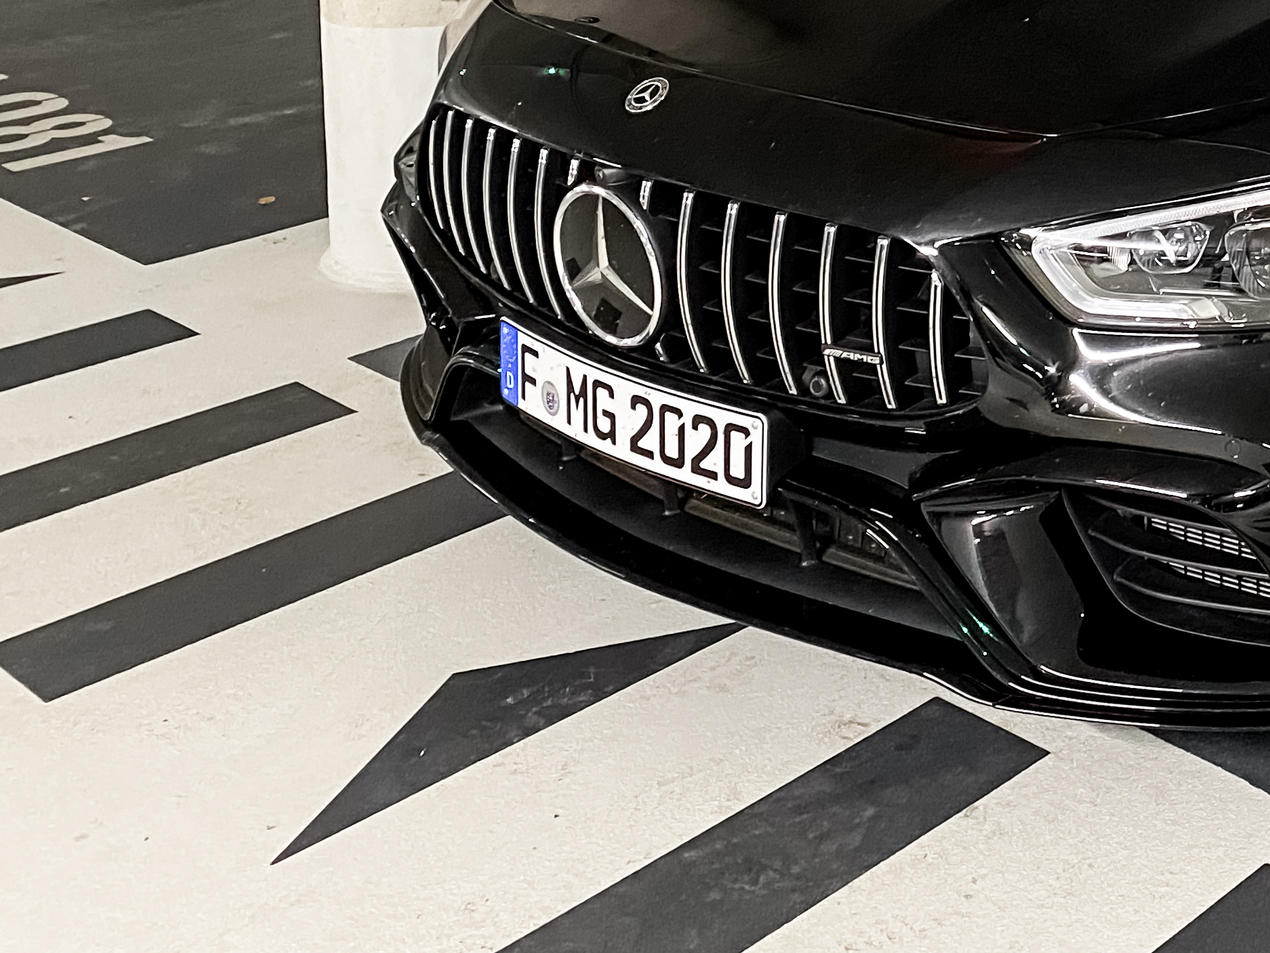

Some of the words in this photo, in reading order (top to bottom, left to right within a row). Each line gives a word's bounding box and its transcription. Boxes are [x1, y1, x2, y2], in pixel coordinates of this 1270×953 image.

[841, 351, 880, 364] AMG
[506, 370, 515, 389] D
[521, 344, 539, 401] F
[566, 365, 616, 446] MG
[629, 394, 752, 490] 2020
